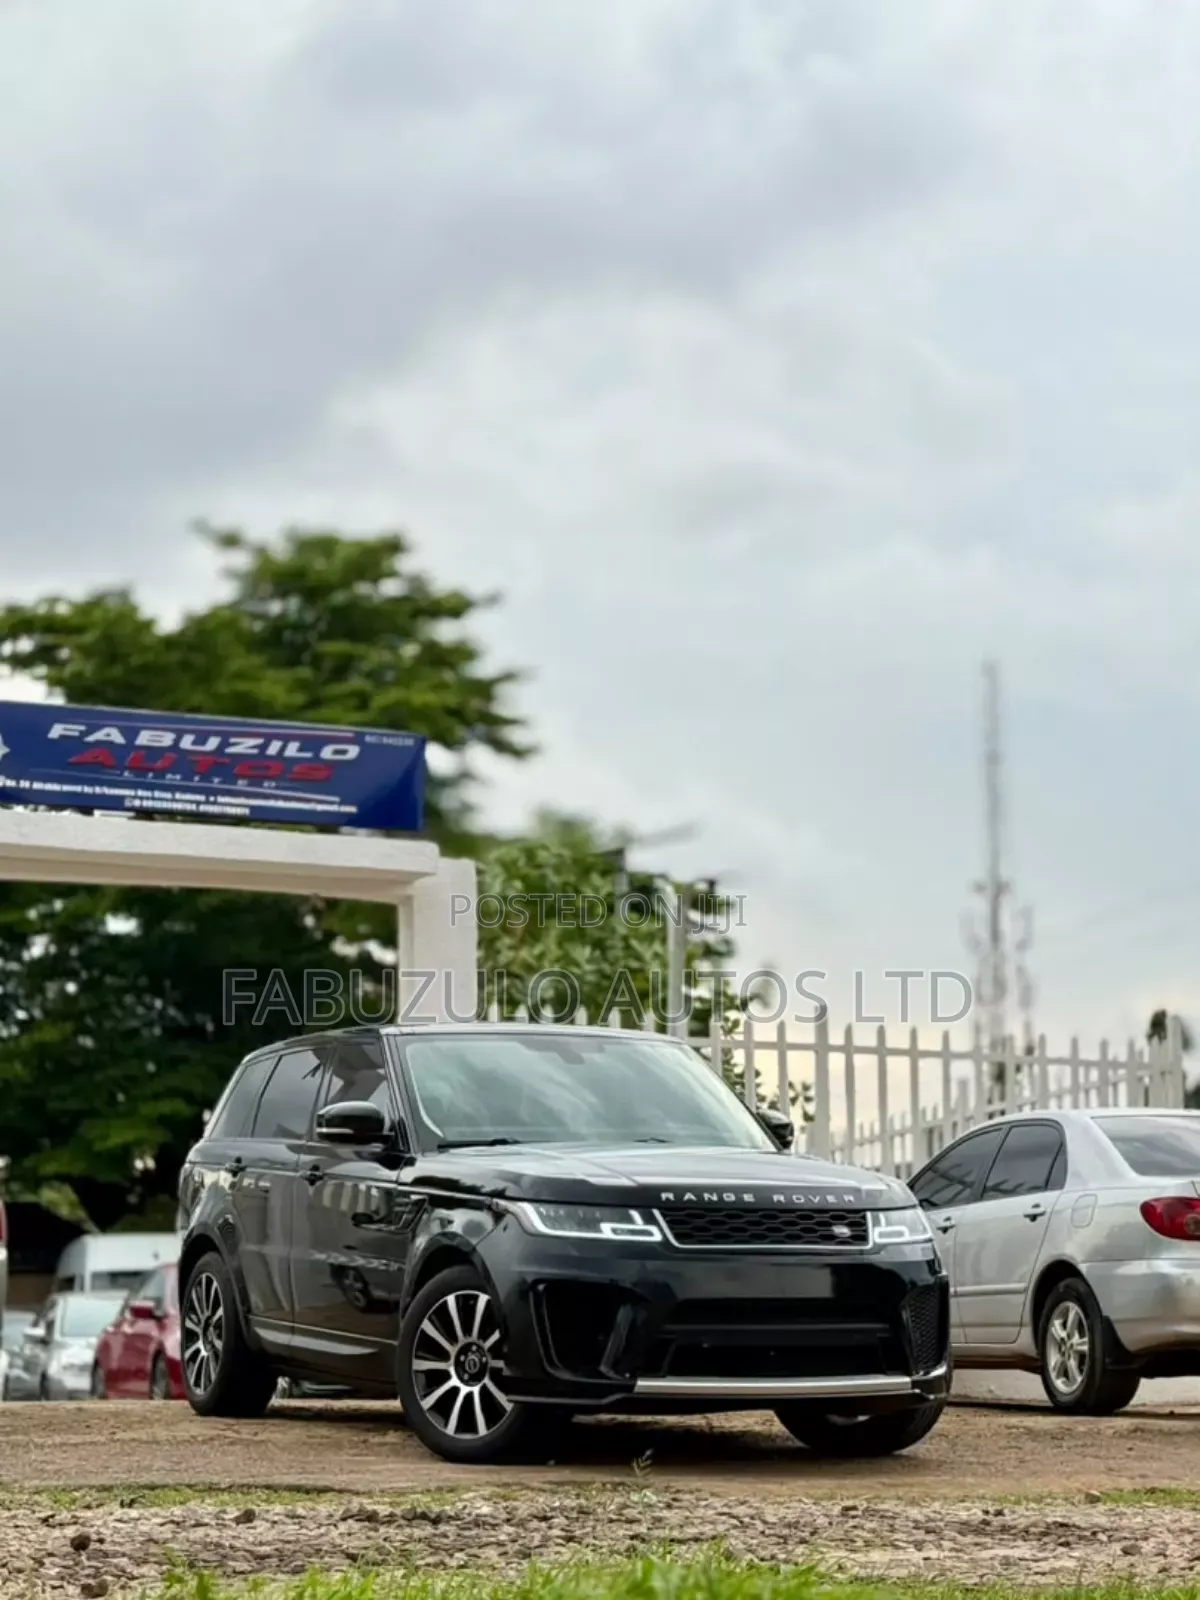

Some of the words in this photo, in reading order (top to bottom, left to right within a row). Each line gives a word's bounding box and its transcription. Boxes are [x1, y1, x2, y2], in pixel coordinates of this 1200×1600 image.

[47, 723, 361, 761] FABUZILO
[67, 748, 334, 781] AUTOS
[123, 770, 277, 788] LIMITED
[660, 1192, 755, 1202] RANGE
[772, 1194, 855, 1204] ROVER
